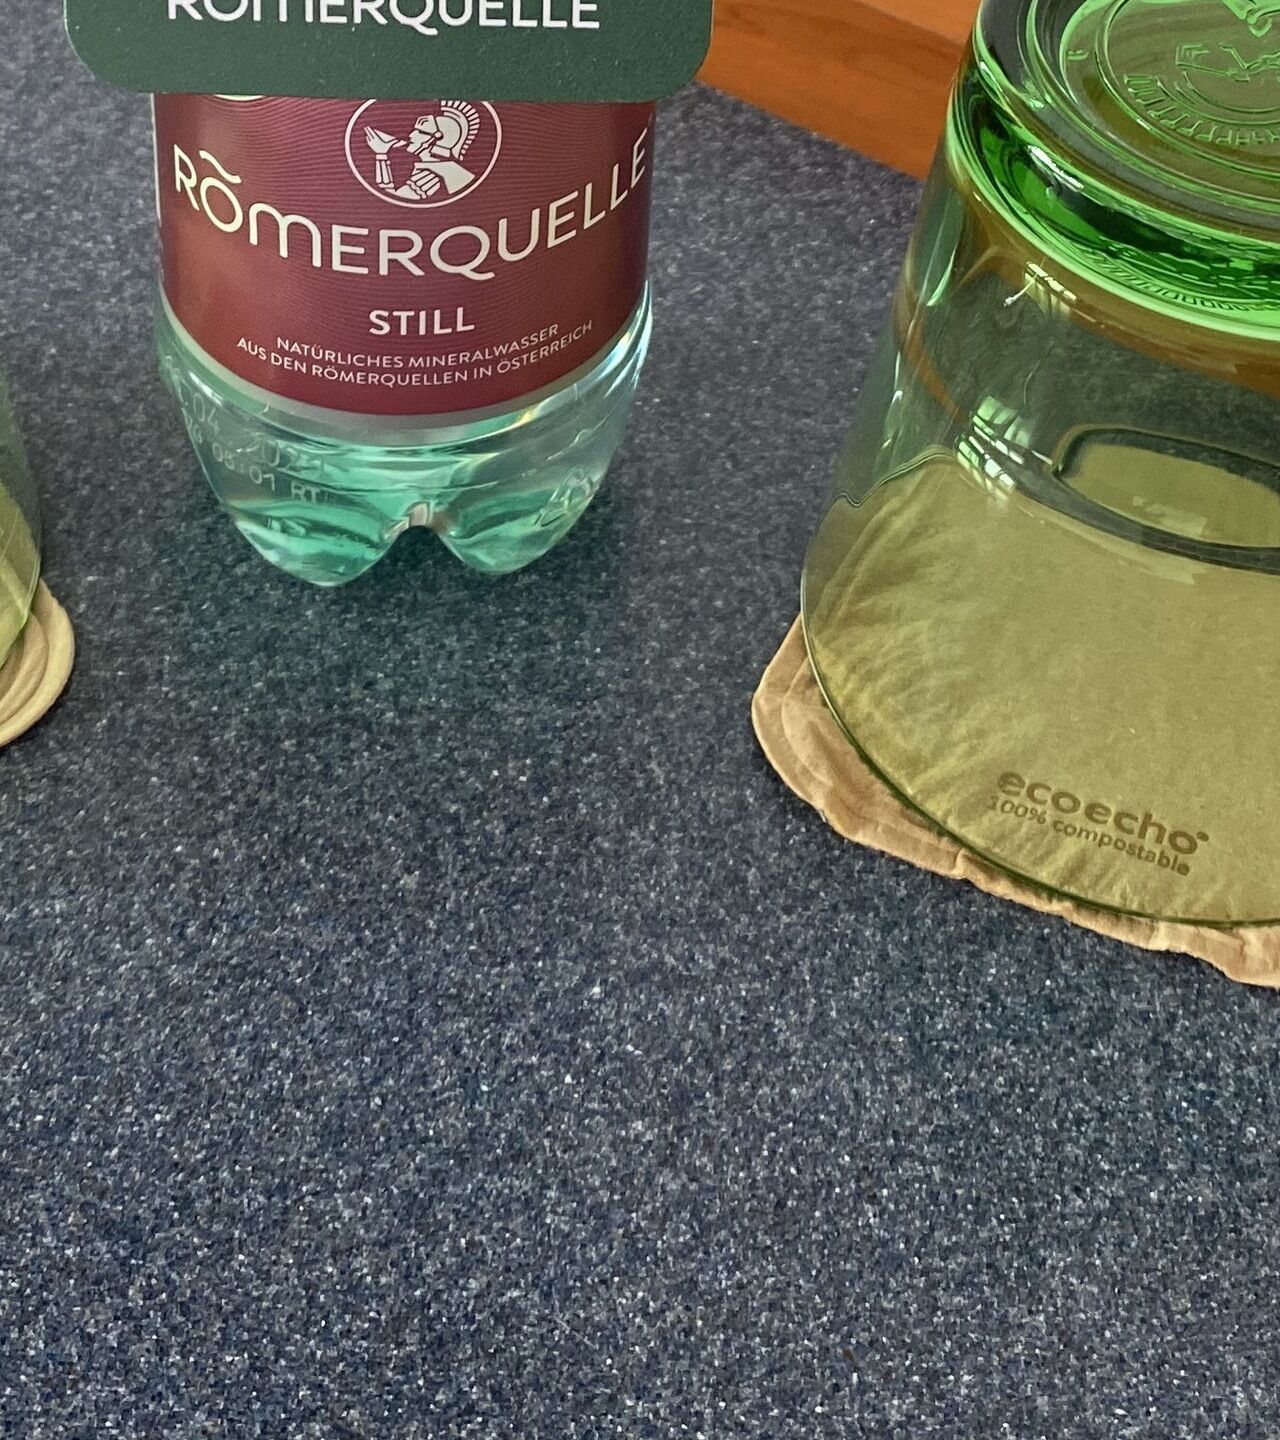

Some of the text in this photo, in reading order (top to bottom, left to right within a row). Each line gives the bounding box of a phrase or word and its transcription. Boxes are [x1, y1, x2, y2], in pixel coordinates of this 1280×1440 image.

[276, 323, 559, 369] NATÜRLICHES MINERALWASSER
[369, 306, 476, 336] STILL
[236, 319, 594, 389] AUS DEN RÖMERQUELLEN IN ÖSTERREICH
[988, 795, 1191, 877] 100% compostable
